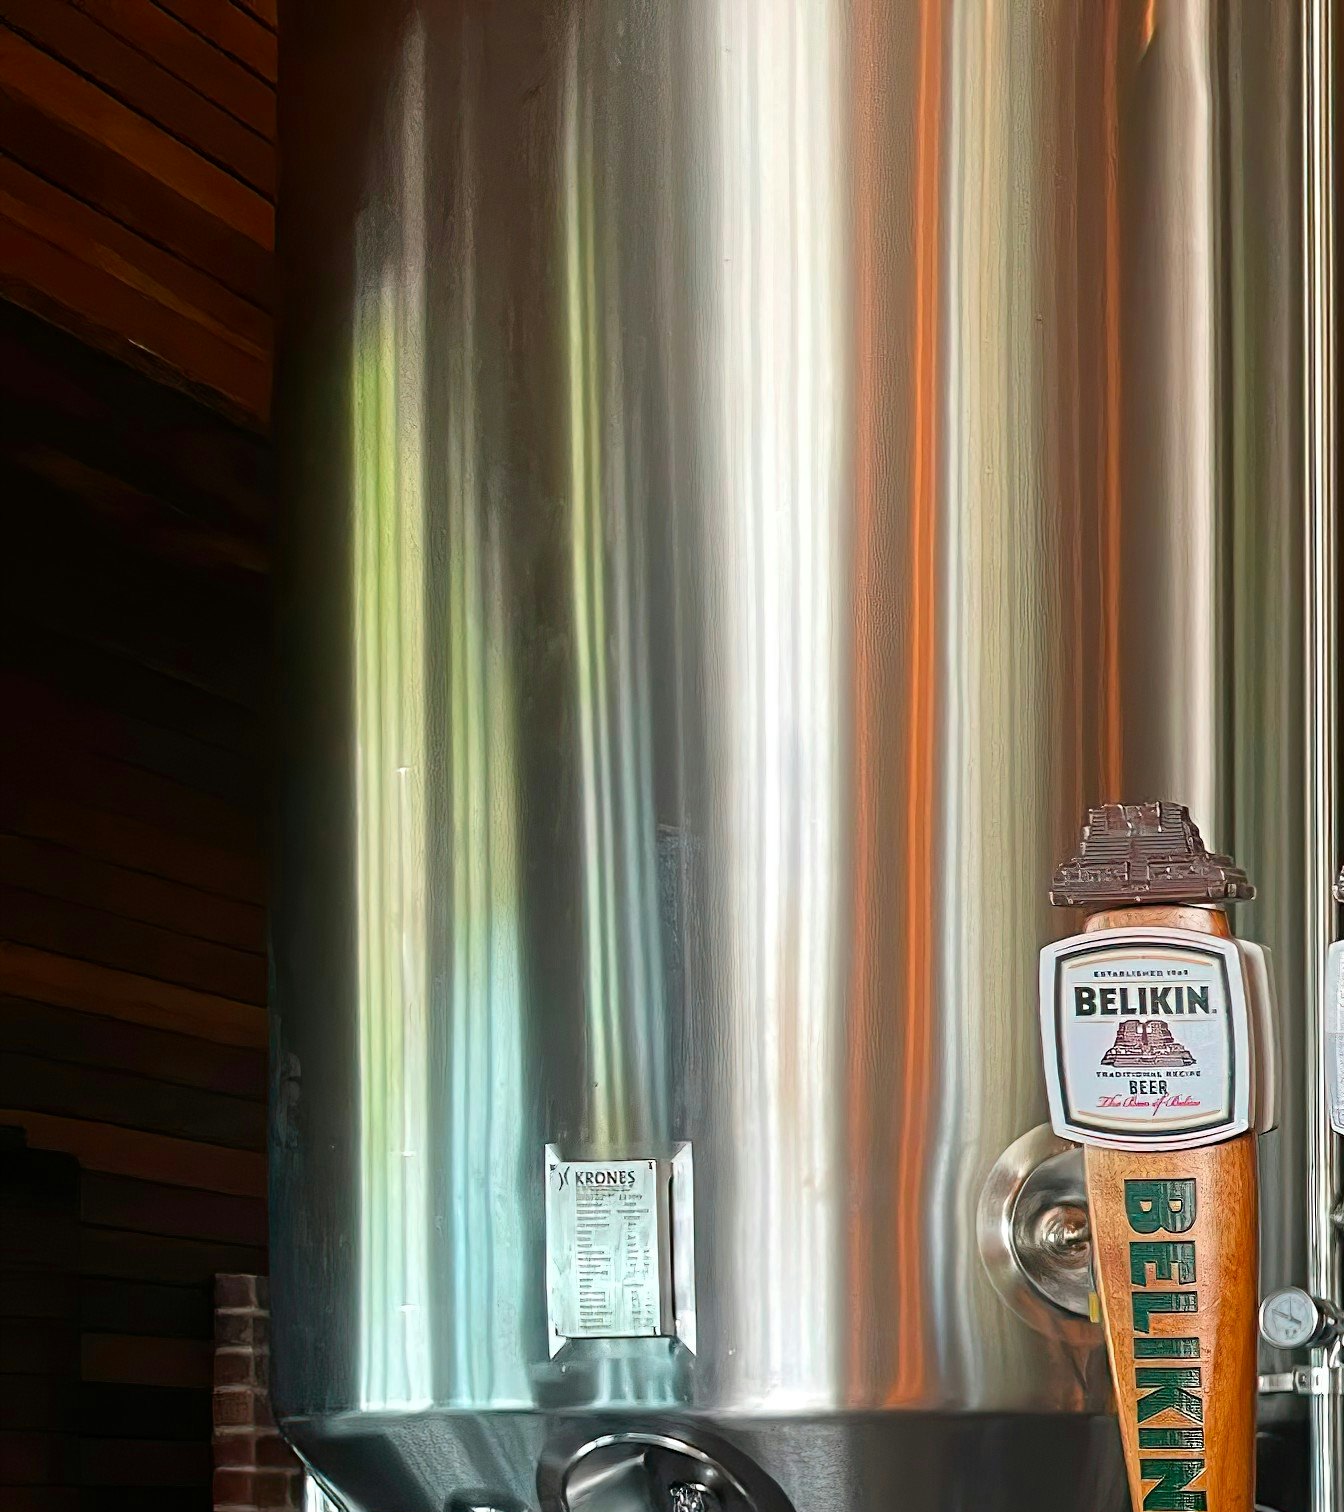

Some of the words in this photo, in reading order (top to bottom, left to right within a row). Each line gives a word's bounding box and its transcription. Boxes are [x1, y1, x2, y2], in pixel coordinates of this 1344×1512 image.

[1129, 1080, 1168, 1095] BEER
[575, 1170, 636, 1189] KRONES
[1124, 1178, 1208, 1512] BELIKIN
